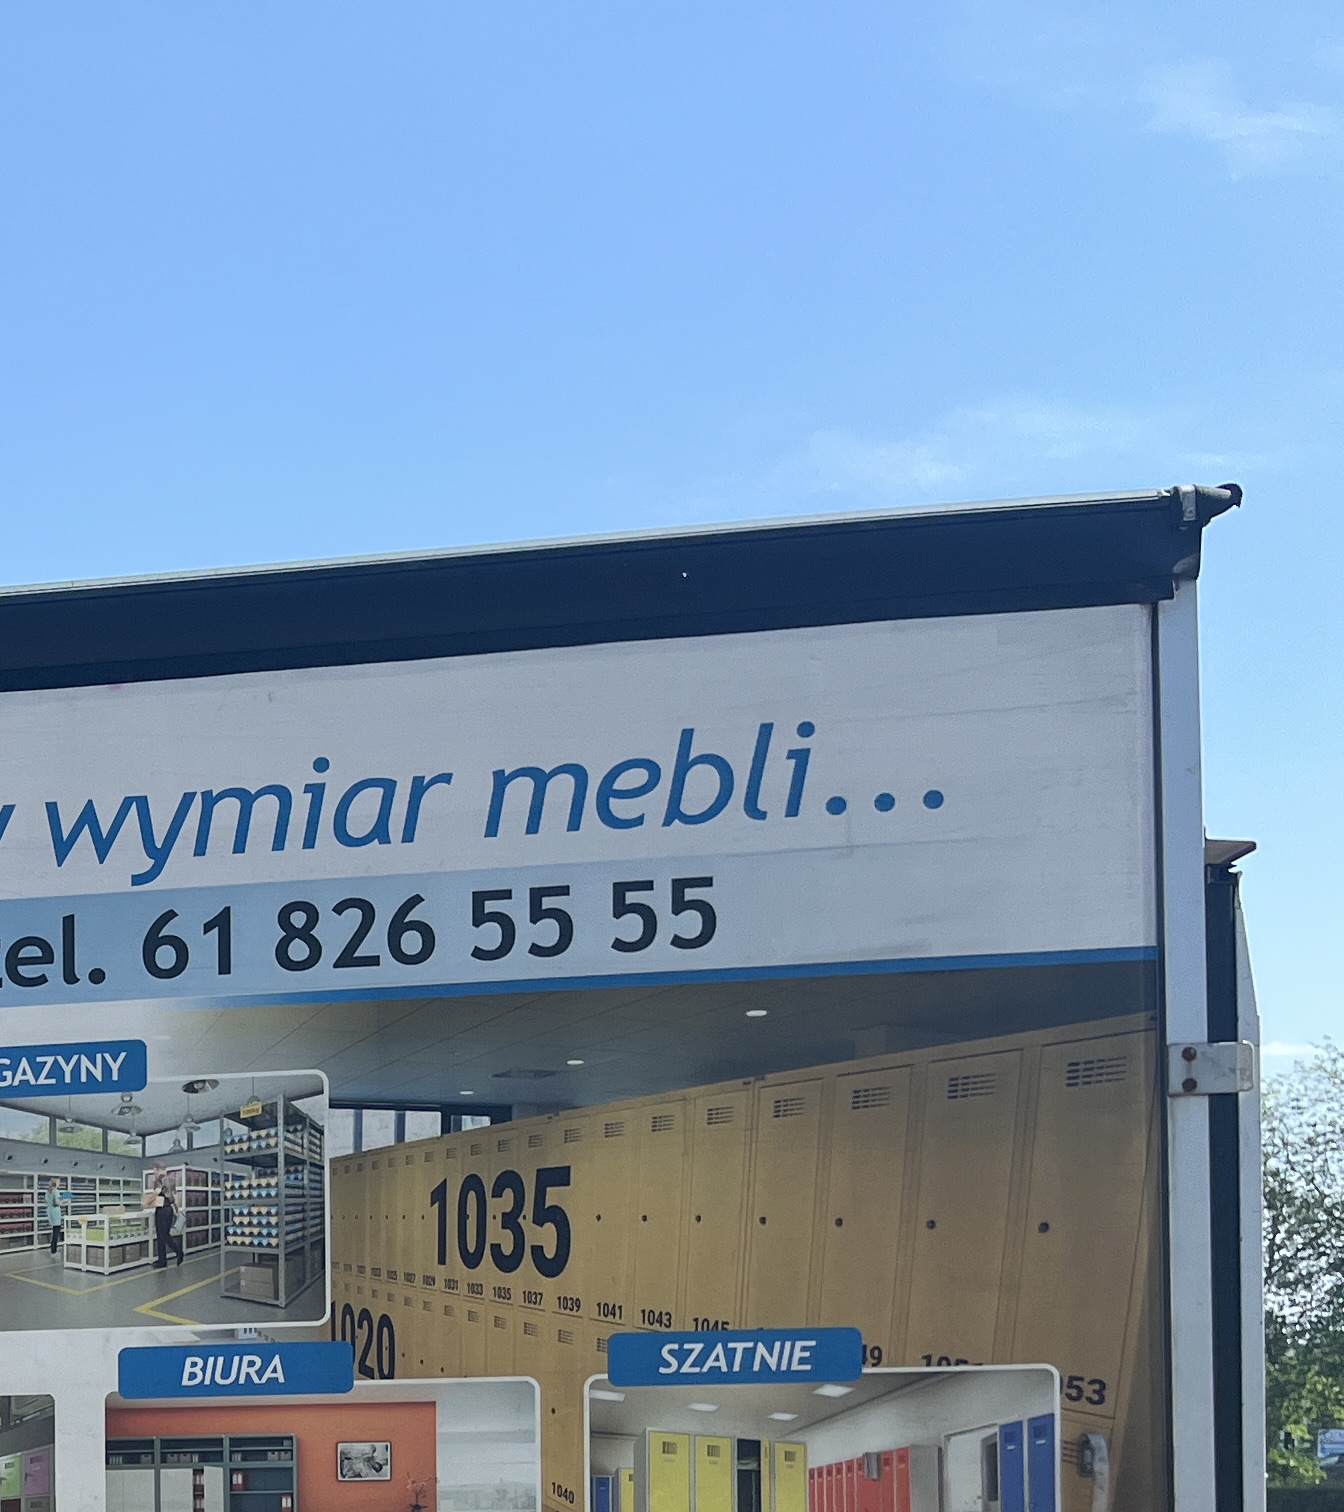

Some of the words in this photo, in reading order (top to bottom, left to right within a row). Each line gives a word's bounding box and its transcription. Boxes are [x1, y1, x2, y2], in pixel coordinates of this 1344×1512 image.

[44, 756, 453, 887] wymiar
[483, 720, 945, 838] mebli...
[141, 905, 232, 980] 61
[273, 892, 437, 973] 826
[469, 884, 575, 962] 55
[609, 875, 719, 954] 55
[429, 1166, 573, 1280] 1035
[181, 1353, 285, 1387] BIURA
[466, 1282, 484, 1296] 1033
[492, 1286, 512, 1301] 1035
[522, 1290, 543, 1306] 1037
[556, 1295, 581, 1313] 1039
[596, 1301, 623, 1320] 1041
[641, 1308, 673, 1329] 1043
[1060, 1375, 1107, 1406] 53
[658, 1340, 817, 1374] SZATNIE
[551, 1481, 575, 1505] 1040
